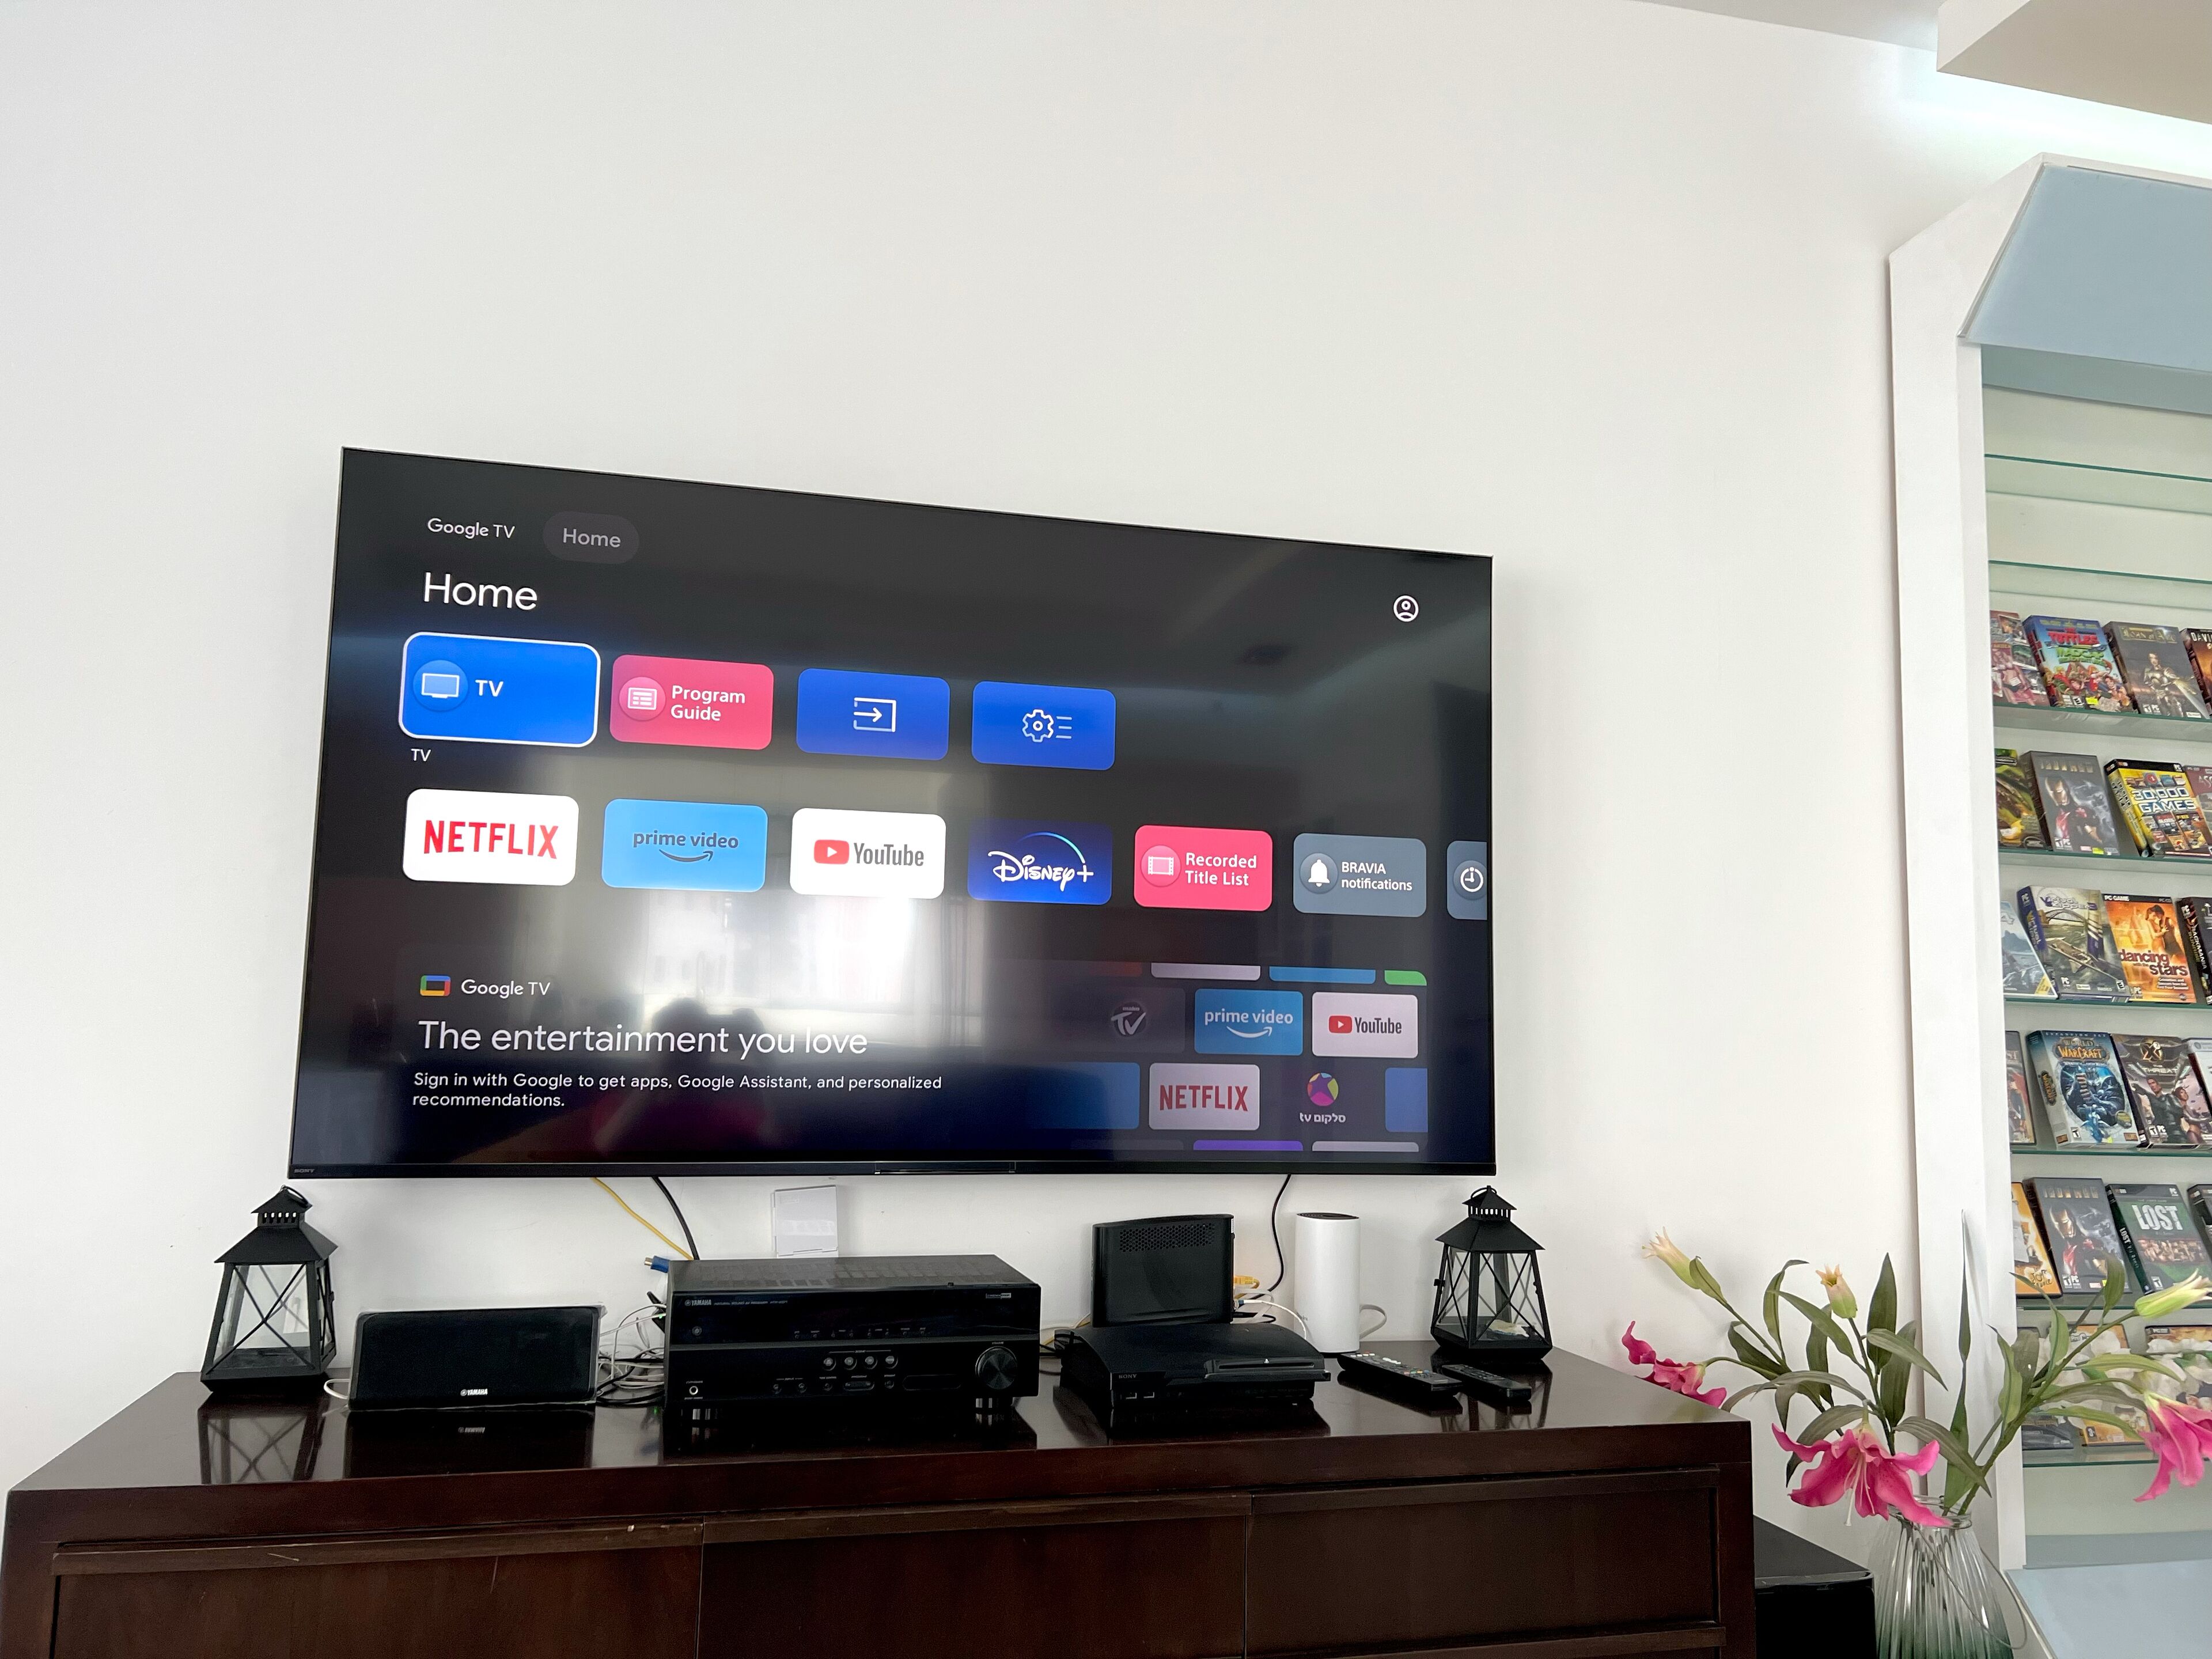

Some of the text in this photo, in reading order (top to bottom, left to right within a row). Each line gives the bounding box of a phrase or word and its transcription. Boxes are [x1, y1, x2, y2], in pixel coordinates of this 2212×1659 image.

[427, 518, 516, 539] Google TV
[562, 528, 621, 548] Home
[423, 571, 537, 611] Home
[475, 680, 503, 698] TV
[672, 685, 745, 705] Program
[671, 704, 721, 721] Guide
[411, 748, 431, 762] TV
[2132, 787, 2190, 801] 30,000
[2139, 799, 2197, 813] GAMES
[423, 820, 559, 859] NETFLIX
[633, 830, 739, 849] prime video
[853, 843, 925, 867] YouTube
[1185, 852, 1257, 869] Recorded
[1342, 861, 1386, 875] BRAVIA
[1185, 870, 1249, 887] Title List
[1341, 877, 1412, 892] notifications
[2119, 949, 2170, 965] dancing
[2149, 963, 2188, 976] stars
[461, 979, 551, 998] Google TV
[1111, 1012, 1146, 1036] TV
[1205, 1009, 1293, 1025] prime video
[1354, 1017, 1402, 1034] YouTube
[419, 1020, 868, 1060] The entertainment you love
[2063, 1039, 2094, 1047] WORLD
[414, 1072, 942, 1092] Sign in with Google to get apps, Google Assistant, and personalized
[412, 1093, 565, 1107] recommendations.
[1160, 1085, 1248, 1111] NETFLIX
[1300, 1112, 1346, 1124] סלקום tv
[2131, 1205, 2183, 1230] LOST
[467, 1388, 488, 1396] YAMAHA
